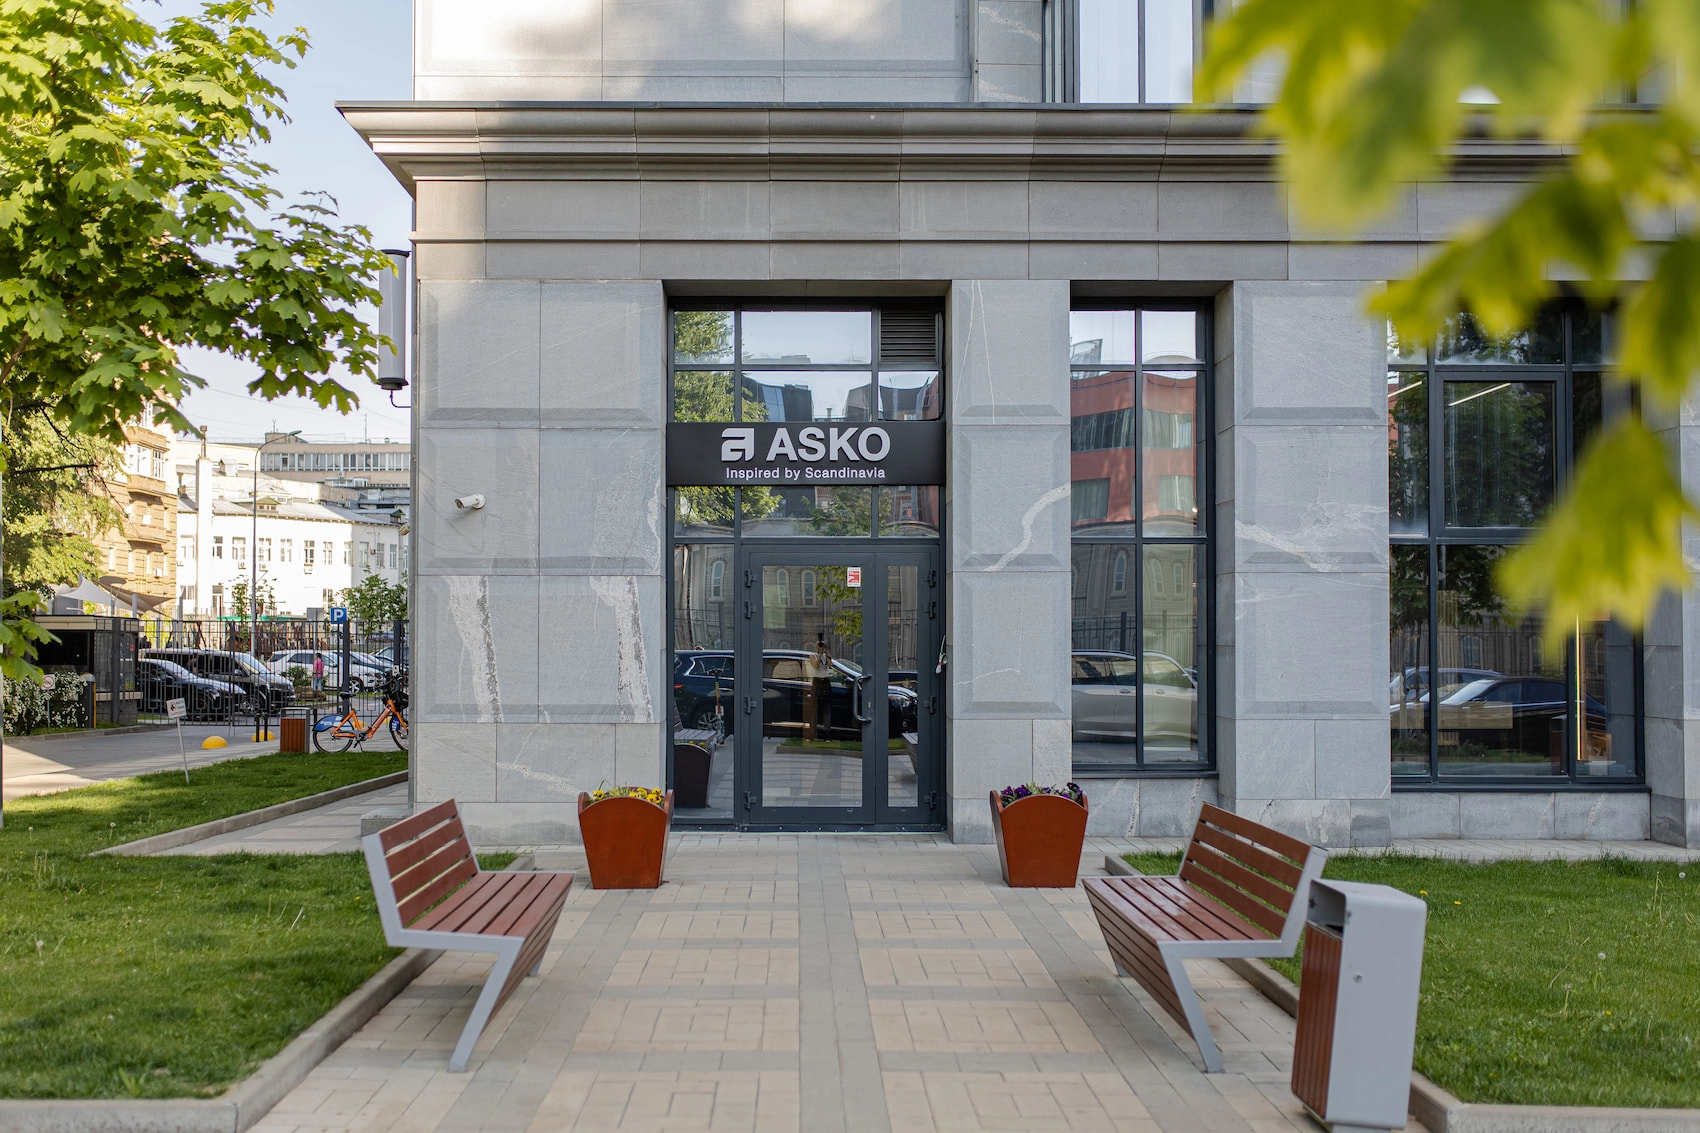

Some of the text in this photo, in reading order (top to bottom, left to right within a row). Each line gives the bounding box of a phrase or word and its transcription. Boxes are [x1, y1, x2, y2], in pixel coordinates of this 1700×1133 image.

[766, 426, 891, 462] ASKO
[726, 467, 886, 481] Inspired by Scandinavia
[334, 609, 344, 621] P
